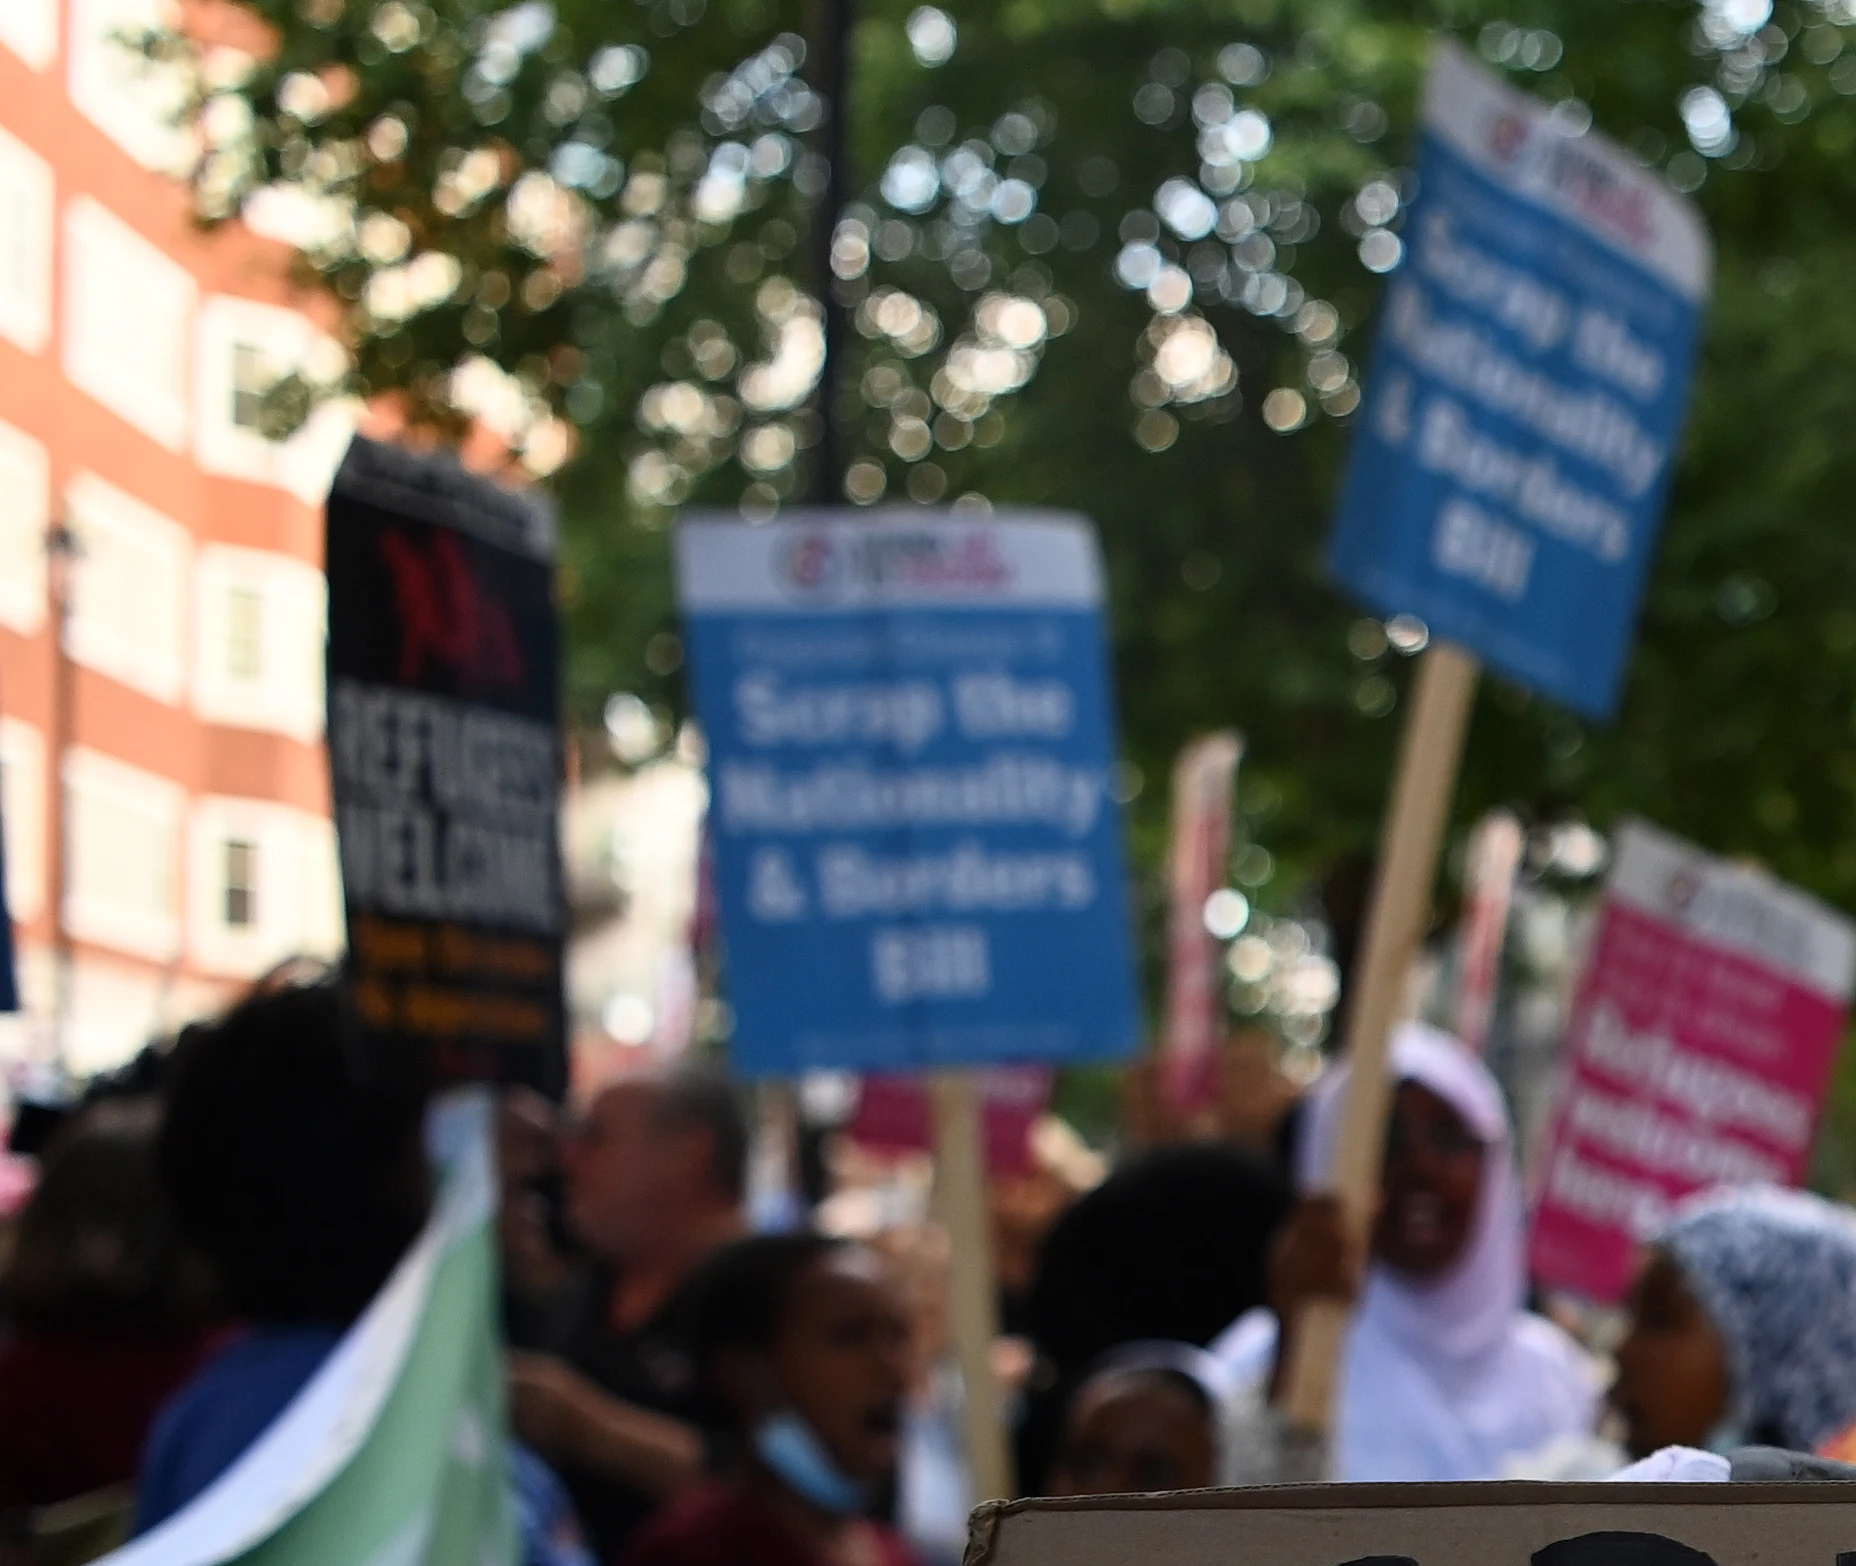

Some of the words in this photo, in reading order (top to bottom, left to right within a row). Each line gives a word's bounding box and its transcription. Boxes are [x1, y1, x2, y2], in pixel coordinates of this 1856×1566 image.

[738, 675, 939, 751] Scrap
[958, 675, 1072, 736] the
[724, 762, 1096, 834] Nationality
[752, 850, 804, 918] &
[822, 848, 1094, 914] Borders
[875, 930, 988, 999] Bill
